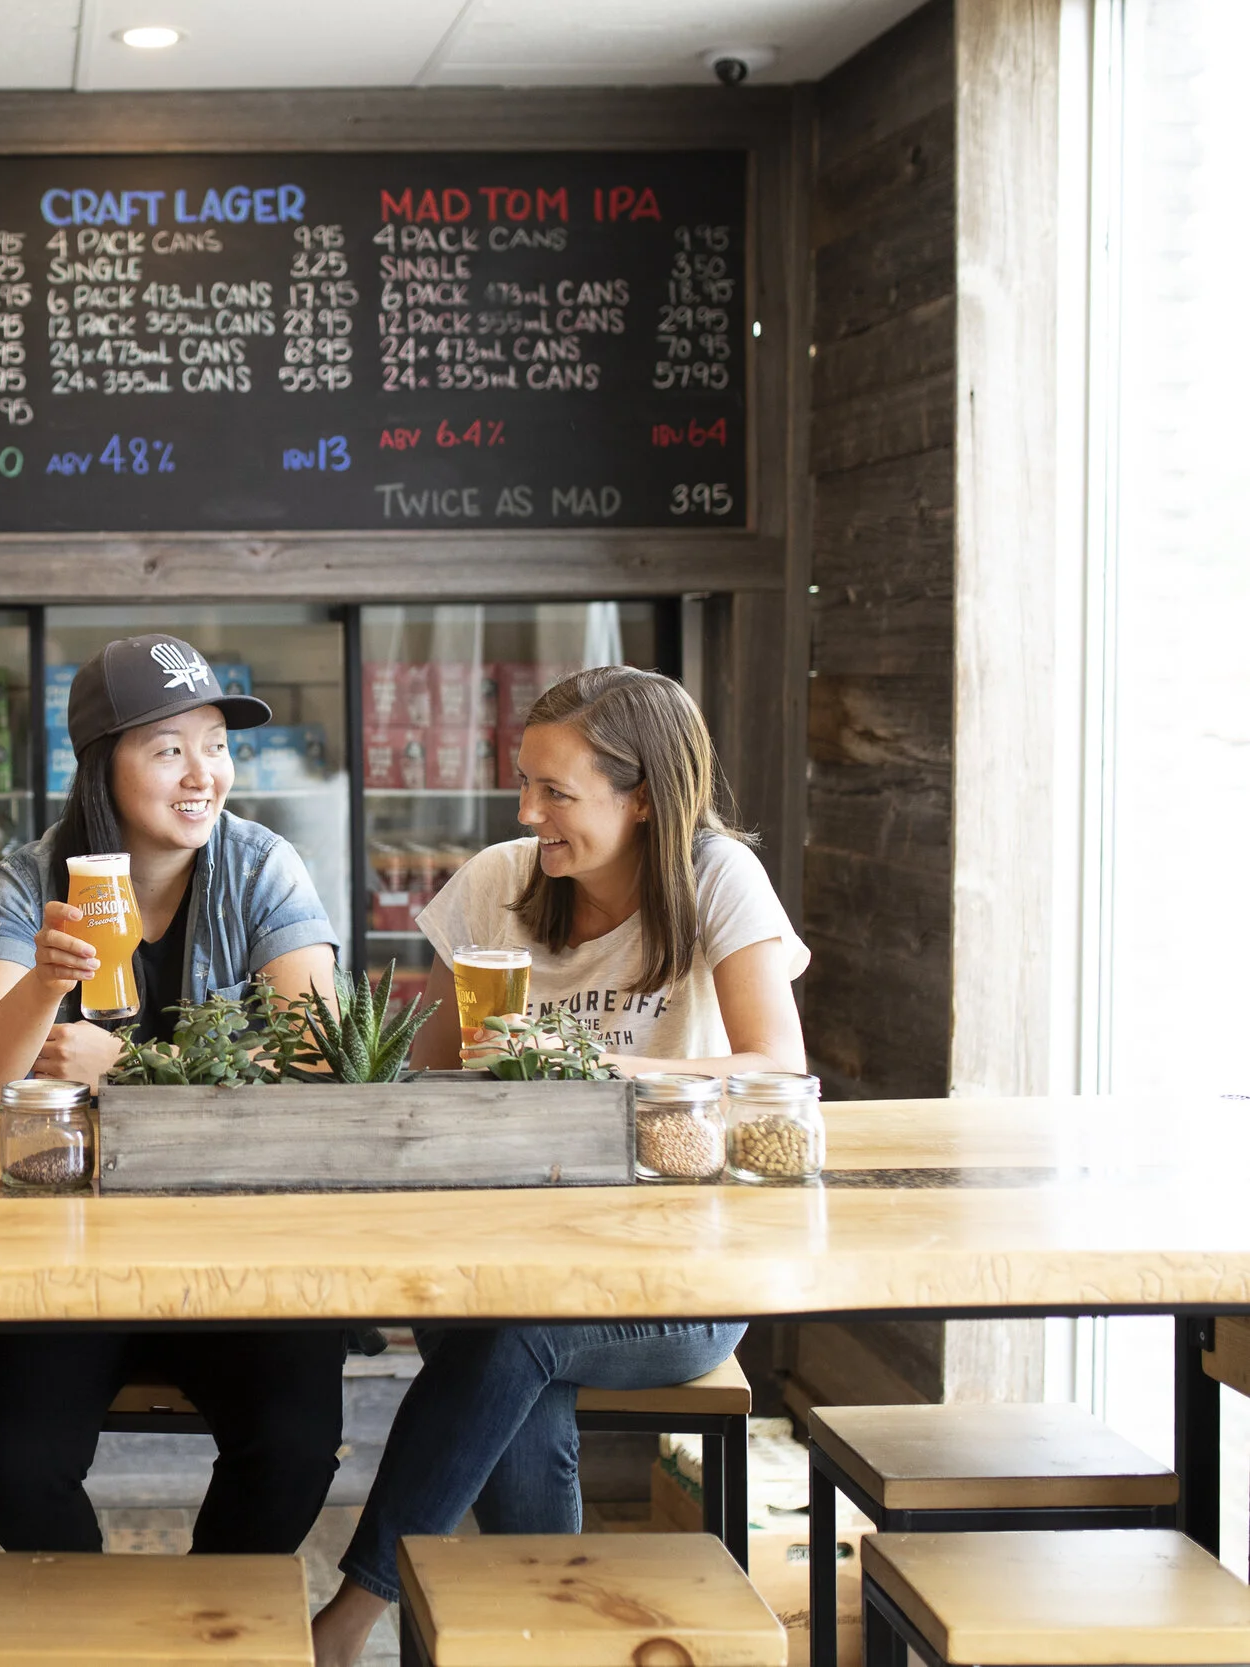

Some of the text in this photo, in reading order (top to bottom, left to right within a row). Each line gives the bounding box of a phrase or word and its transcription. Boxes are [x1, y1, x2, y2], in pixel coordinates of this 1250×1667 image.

[40, 184, 305, 226] CRAFT LAGER
[380, 185, 662, 224] MAD TOM IPA
[46, 228, 68, 258] 4
[77, 230, 146, 255] PACK
[152, 229, 223, 254] CANS
[372, 224, 395, 253] 4
[401, 226, 479, 251] PACK
[489, 227, 568, 250] CANS
[47, 257, 143, 284] SINGLE
[379, 254, 472, 281] SINGLE
[47, 288, 69, 316] 6
[73, 285, 136, 310] PACK
[210, 280, 273, 310] CANS
[289, 281, 359, 309] 17.95
[381, 282, 402, 312] 6
[406, 282, 469, 306] PACK
[556, 279, 629, 306] CANS
[49, 318, 73, 339] 12
[77, 313, 136, 336] PACK
[215, 310, 276, 336] CANS
[283, 308, 353, 336] 28.95
[378, 312, 406, 336] 12
[408, 312, 471, 335] PACK
[556, 309, 625, 334] CANS
[658, 306, 729, 332] 29.95
[178, 338, 246, 365] CANS
[512, 337, 581, 362] CANS
[182, 365, 251, 394] CANS
[278, 364, 352, 393] 55.95
[526, 362, 729, 390] CANS 57.95
[380, 418, 726, 450] ABV 6.4% IBU 64
[46, 452, 93, 475] ABV
[318, 435, 350, 472] 13
[375, 483, 733, 518] TWICE AS MAD 3.95
